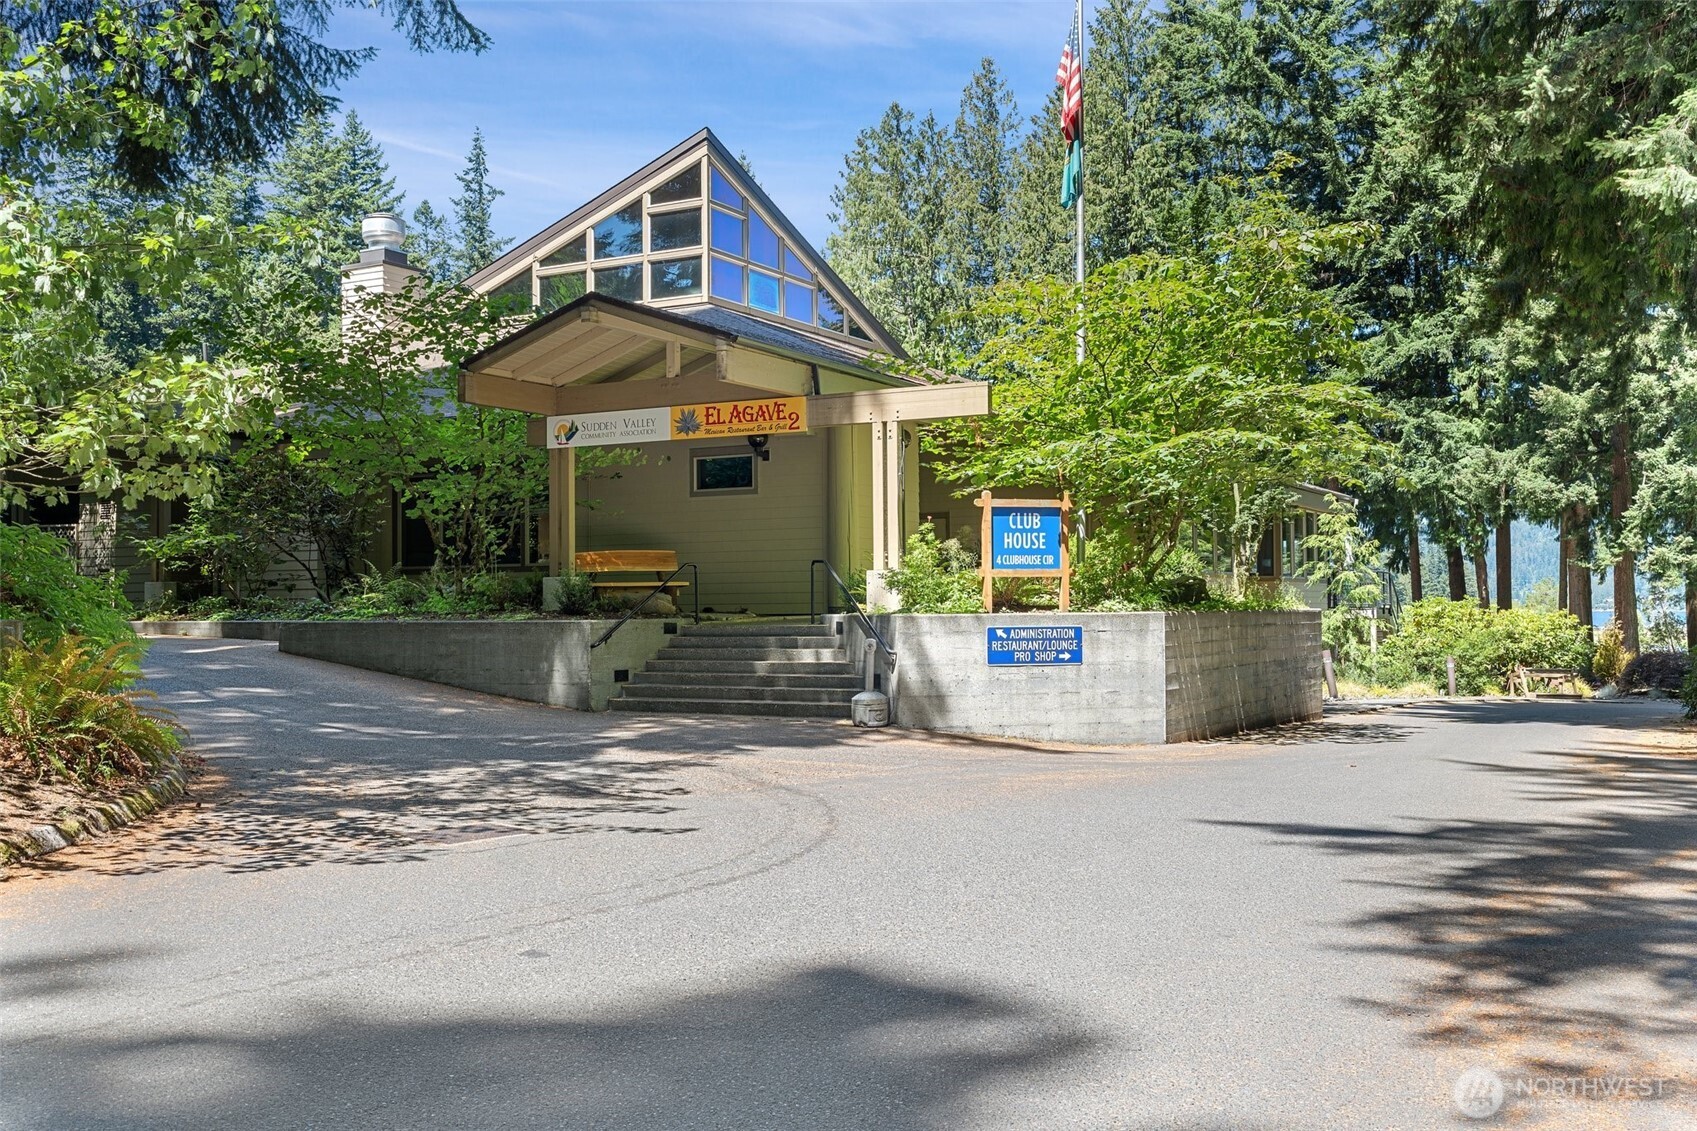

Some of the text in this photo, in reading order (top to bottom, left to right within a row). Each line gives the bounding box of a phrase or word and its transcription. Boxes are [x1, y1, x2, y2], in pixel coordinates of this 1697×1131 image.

[728, 401, 787, 424] AGAVE
[788, 412, 800, 430] 2
[581, 417, 656, 432] SUDDEN VALLEY
[727, 426, 755, 434] Restaurant
[775, 423, 787, 432] Grill
[580, 428, 657, 440] COMMUNITY ASSOCIATION
[1008, 512, 1041, 529] CLUB
[1003, 532, 1046, 549] HOUSE
[996, 555, 1054, 565] 4 CLUBHOUSE CIR
[1009, 628, 1075, 639] ADMINISTRATION
[991, 640, 1078, 651] RESTAURANT/LOUNGE
[1014, 651, 1057, 662] PRO SHOP
